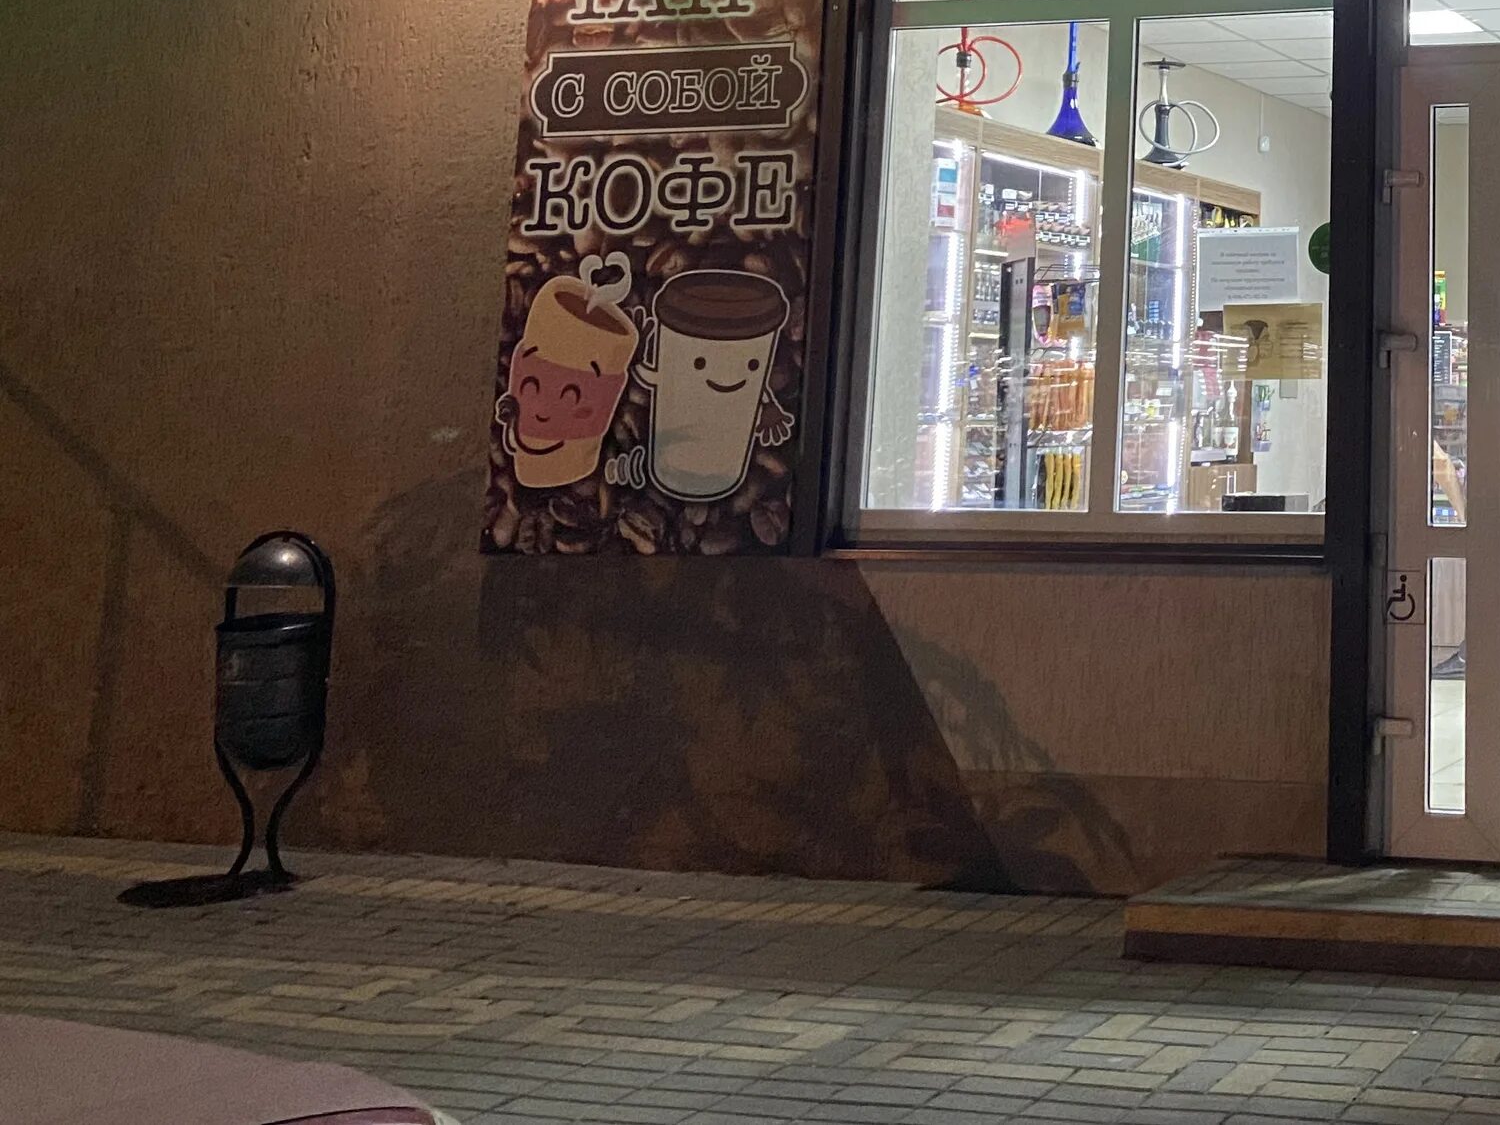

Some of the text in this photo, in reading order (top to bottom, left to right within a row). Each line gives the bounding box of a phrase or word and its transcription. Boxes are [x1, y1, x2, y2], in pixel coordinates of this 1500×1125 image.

[551, 54, 783, 118] С СОБОЙ
[520, 150, 798, 237] КОФЕ
